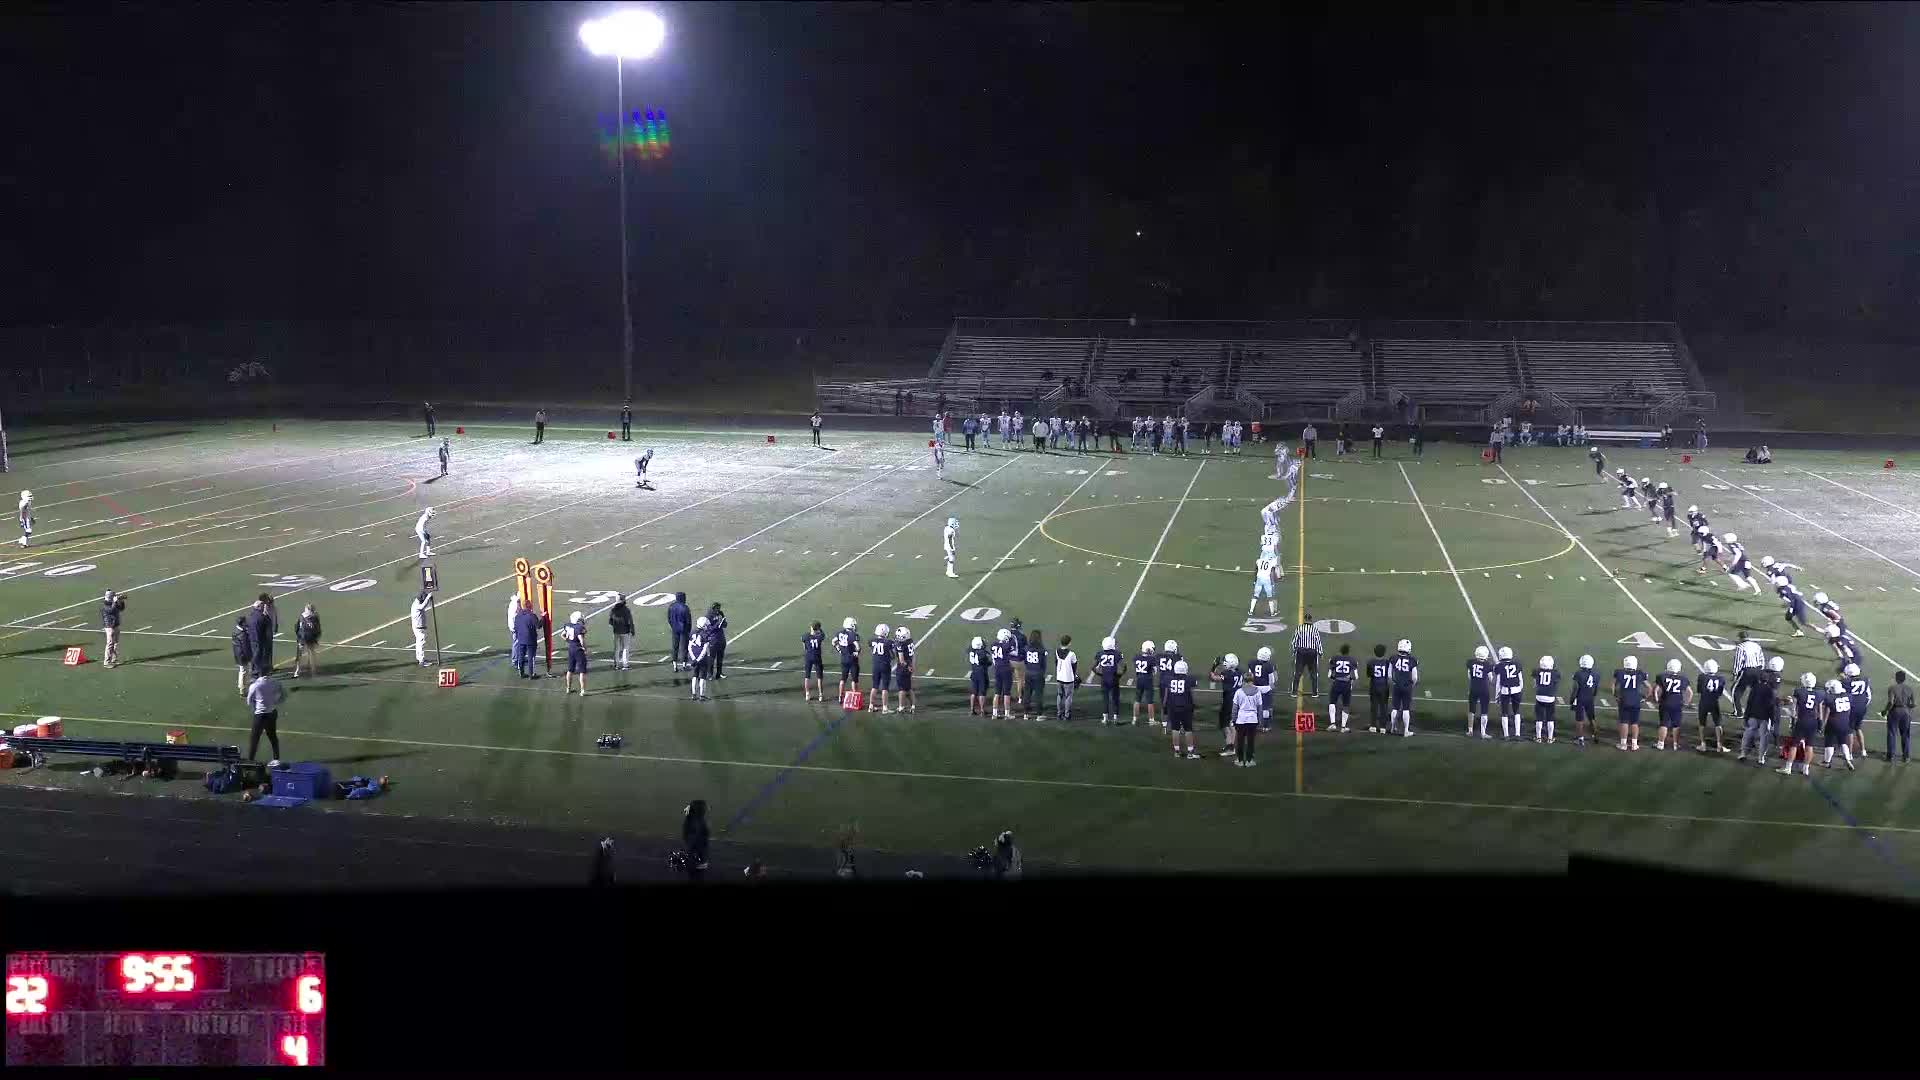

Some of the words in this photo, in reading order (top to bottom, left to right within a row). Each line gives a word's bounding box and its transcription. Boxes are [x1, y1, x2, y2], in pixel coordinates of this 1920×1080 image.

[893, 604, 1002, 621] 40
[1240, 617, 1356, 634] 50
[810, 639, 818, 648] 11
[1617, 631, 1735, 650] 40
[871, 642, 884, 655] 70
[1100, 655, 1114, 667] 23
[1135, 660, 1148, 673] 32
[1160, 658, 1172, 671] 54
[1336, 661, 1349, 674] 25
[1395, 658, 1409, 672] 45
[1255, 665, 1262, 677] 9
[1374, 666, 1384, 678] 51
[1472, 664, 1483, 678] 15
[1505, 665, 1516, 678] 12
[1539, 672, 1551, 685] 10
[1586, 675, 1594, 687] 4
[1623, 675, 1636, 688] 71
[1707, 679, 1719, 691] 41
[1171, 680, 1185, 693] 99
[1665, 678, 1681, 693] 72
[1805, 695, 1815, 709] 5
[1298, 714, 1314, 730] 50
[121, 955, 194, 993] 9:55
[6, 976, 48, 1013] 22
[299, 976, 322, 1013] 6
[282, 1035, 308, 1066] 4
